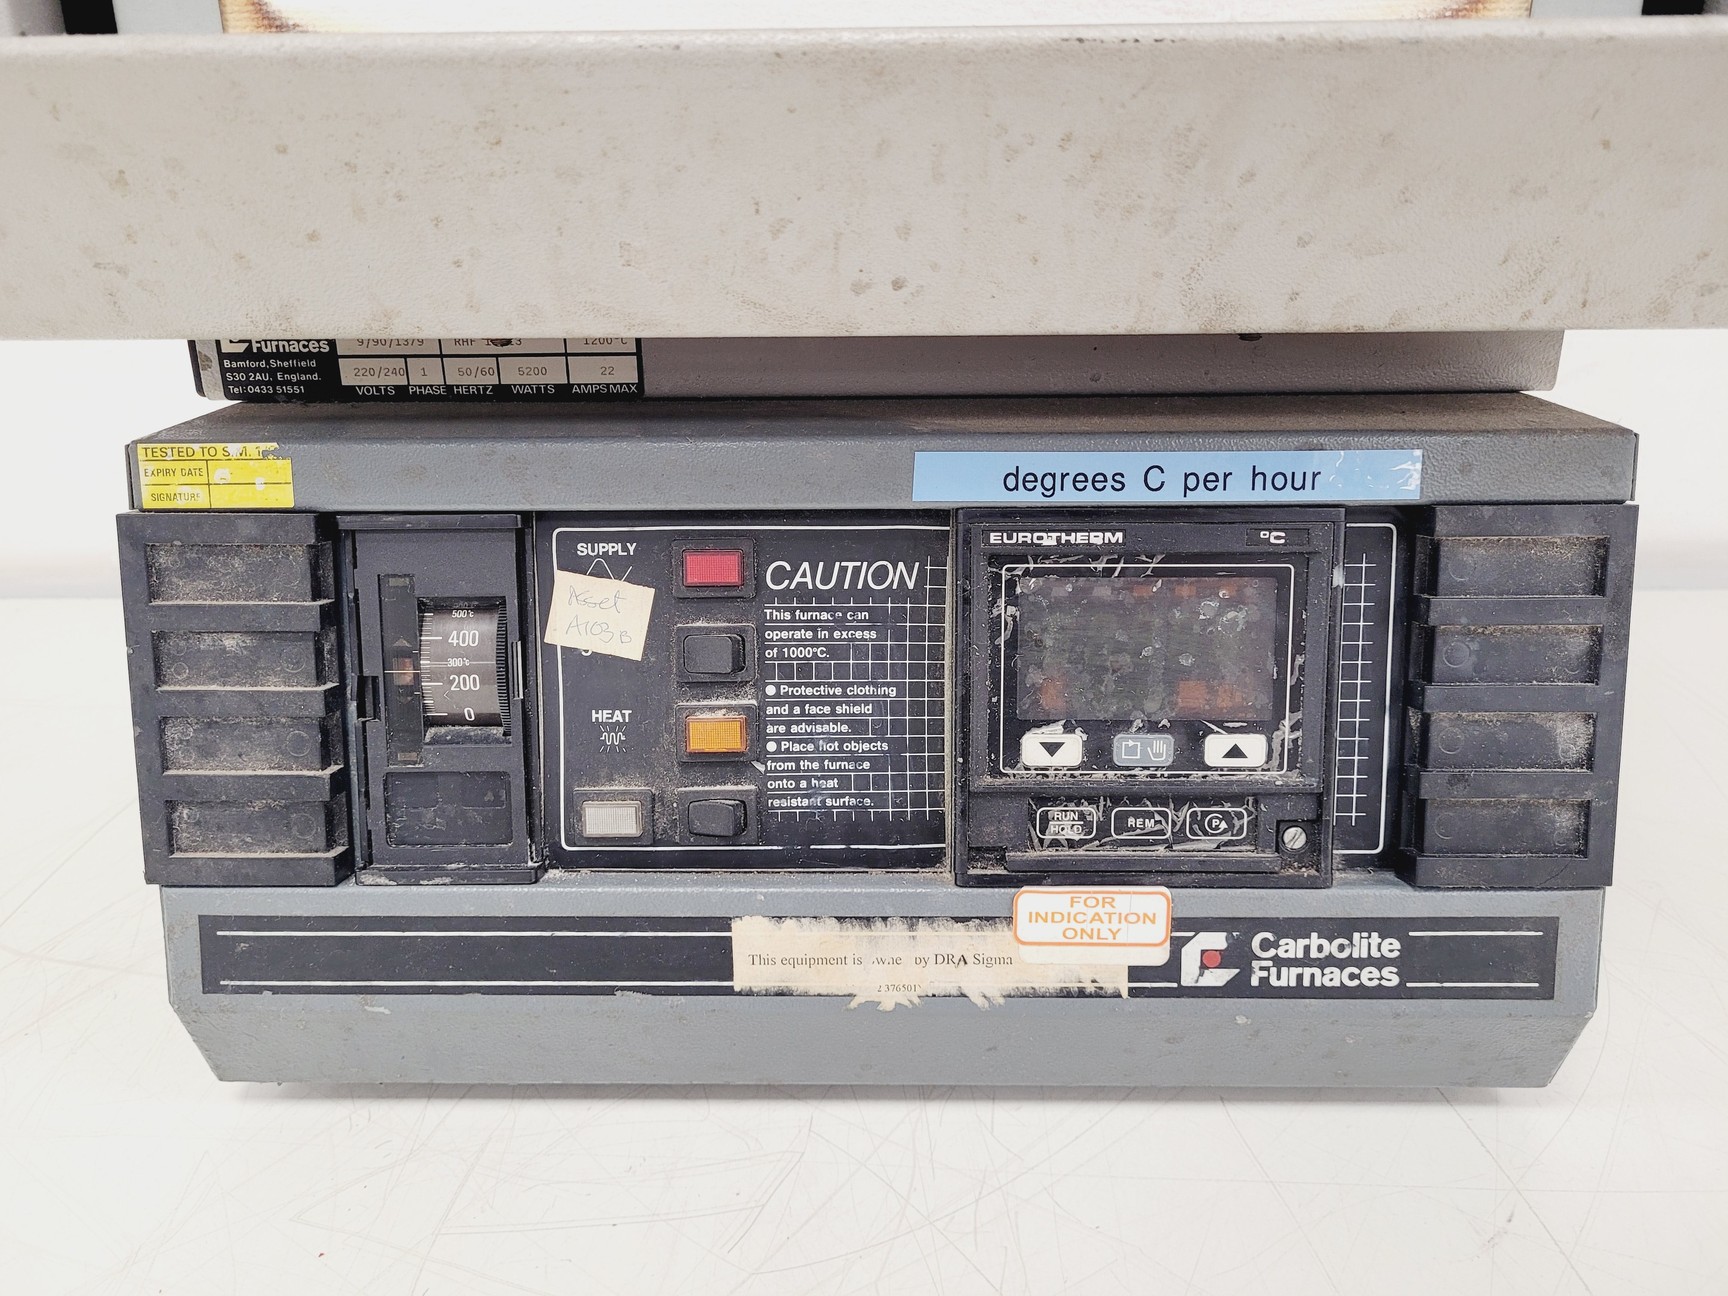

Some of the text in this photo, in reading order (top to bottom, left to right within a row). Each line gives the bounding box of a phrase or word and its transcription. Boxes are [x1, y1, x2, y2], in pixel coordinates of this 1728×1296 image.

[251, 339, 331, 353] Furnaces
[354, 367, 405, 379] 220/240
[422, 367, 428, 377] 1
[457, 366, 495, 379] 50/60
[518, 367, 547, 376] 5200
[600, 366, 615, 376] 22
[226, 373, 246, 381] S30
[278, 372, 322, 383] England.
[277, 386, 306, 394] 51551
[355, 386, 396, 396] VOLTS
[409, 386, 447, 395] PHASE
[454, 386, 493, 395] HERTZ
[511, 385, 555, 395] WATTS
[572, 384, 637, 394] AMPS MAX
[142, 446, 195, 458] TESTED
[199, 446, 217, 458] TO
[144, 468, 203, 477] EXPIRY DATE
[1002, 464, 1322, 498] degrees C per hour
[989, 531, 1124, 546] EUROTHERM
[1260, 531, 1287, 545] °C
[577, 543, 637, 556] SUPPLY
[766, 561, 920, 590] CAUTION
[568, 585, 626, 613] Asset
[764, 609, 869, 620] This furnace can
[448, 630, 480, 648] 400
[765, 628, 877, 641] operate in excess
[765, 647, 830, 658] of 1000°C.
[449, 674, 481, 691] 200
[780, 685, 897, 698] Protective clothing
[463, 707, 476, 721] 0
[766, 704, 788, 714] and
[805, 704, 831, 714] face
[835, 704, 872, 714] shield
[592, 710, 633, 723] HEAT
[766, 723, 852, 734] are advisable.
[781, 740, 889, 753] Place hot objects
[767, 760, 871, 771] from the furnace
[768, 778, 839, 788] onto a heat
[768, 797, 874, 807] resistant surface.
[1054, 811, 1078, 821] RUN
[1127, 818, 1155, 828] REM
[1049, 825, 1082, 835] HOLD
[1070, 896, 1116, 909] FOR
[1028, 911, 1157, 925] INDICATION
[1062, 927, 1122, 940] ONLY
[1251, 932, 1402, 959] Carbolite
[748, 953, 777, 966] This
[781, 953, 848, 969] equipment
[852, 953, 863, 966] is
[934, 953, 968, 969] DRA
[973, 953, 1013, 969] Sigma
[1251, 960, 1401, 987] Furnaces
